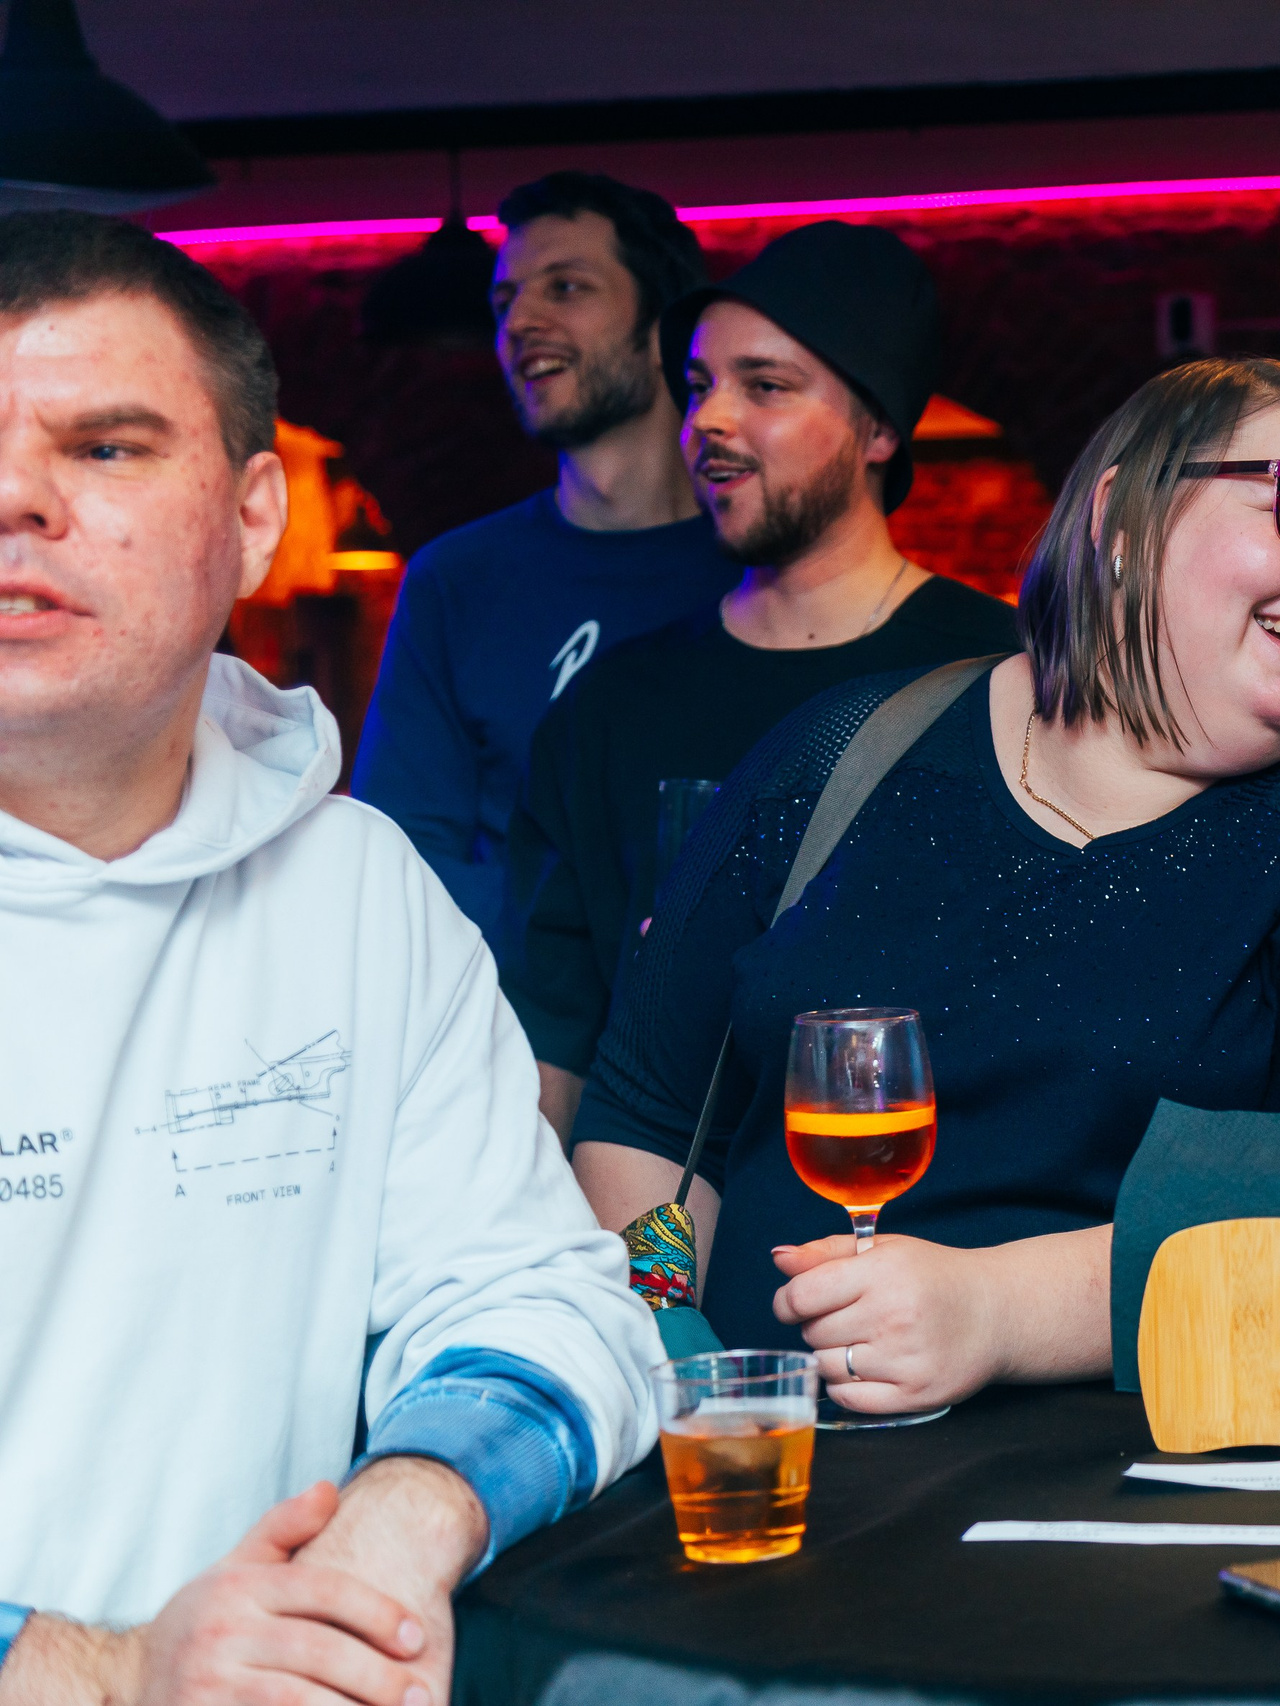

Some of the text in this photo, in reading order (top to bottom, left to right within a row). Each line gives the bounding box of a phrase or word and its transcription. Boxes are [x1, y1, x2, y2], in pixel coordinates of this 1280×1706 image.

[175, 1183, 186, 1198] A
[226, 1184, 301, 1206] FRONT VIEW
